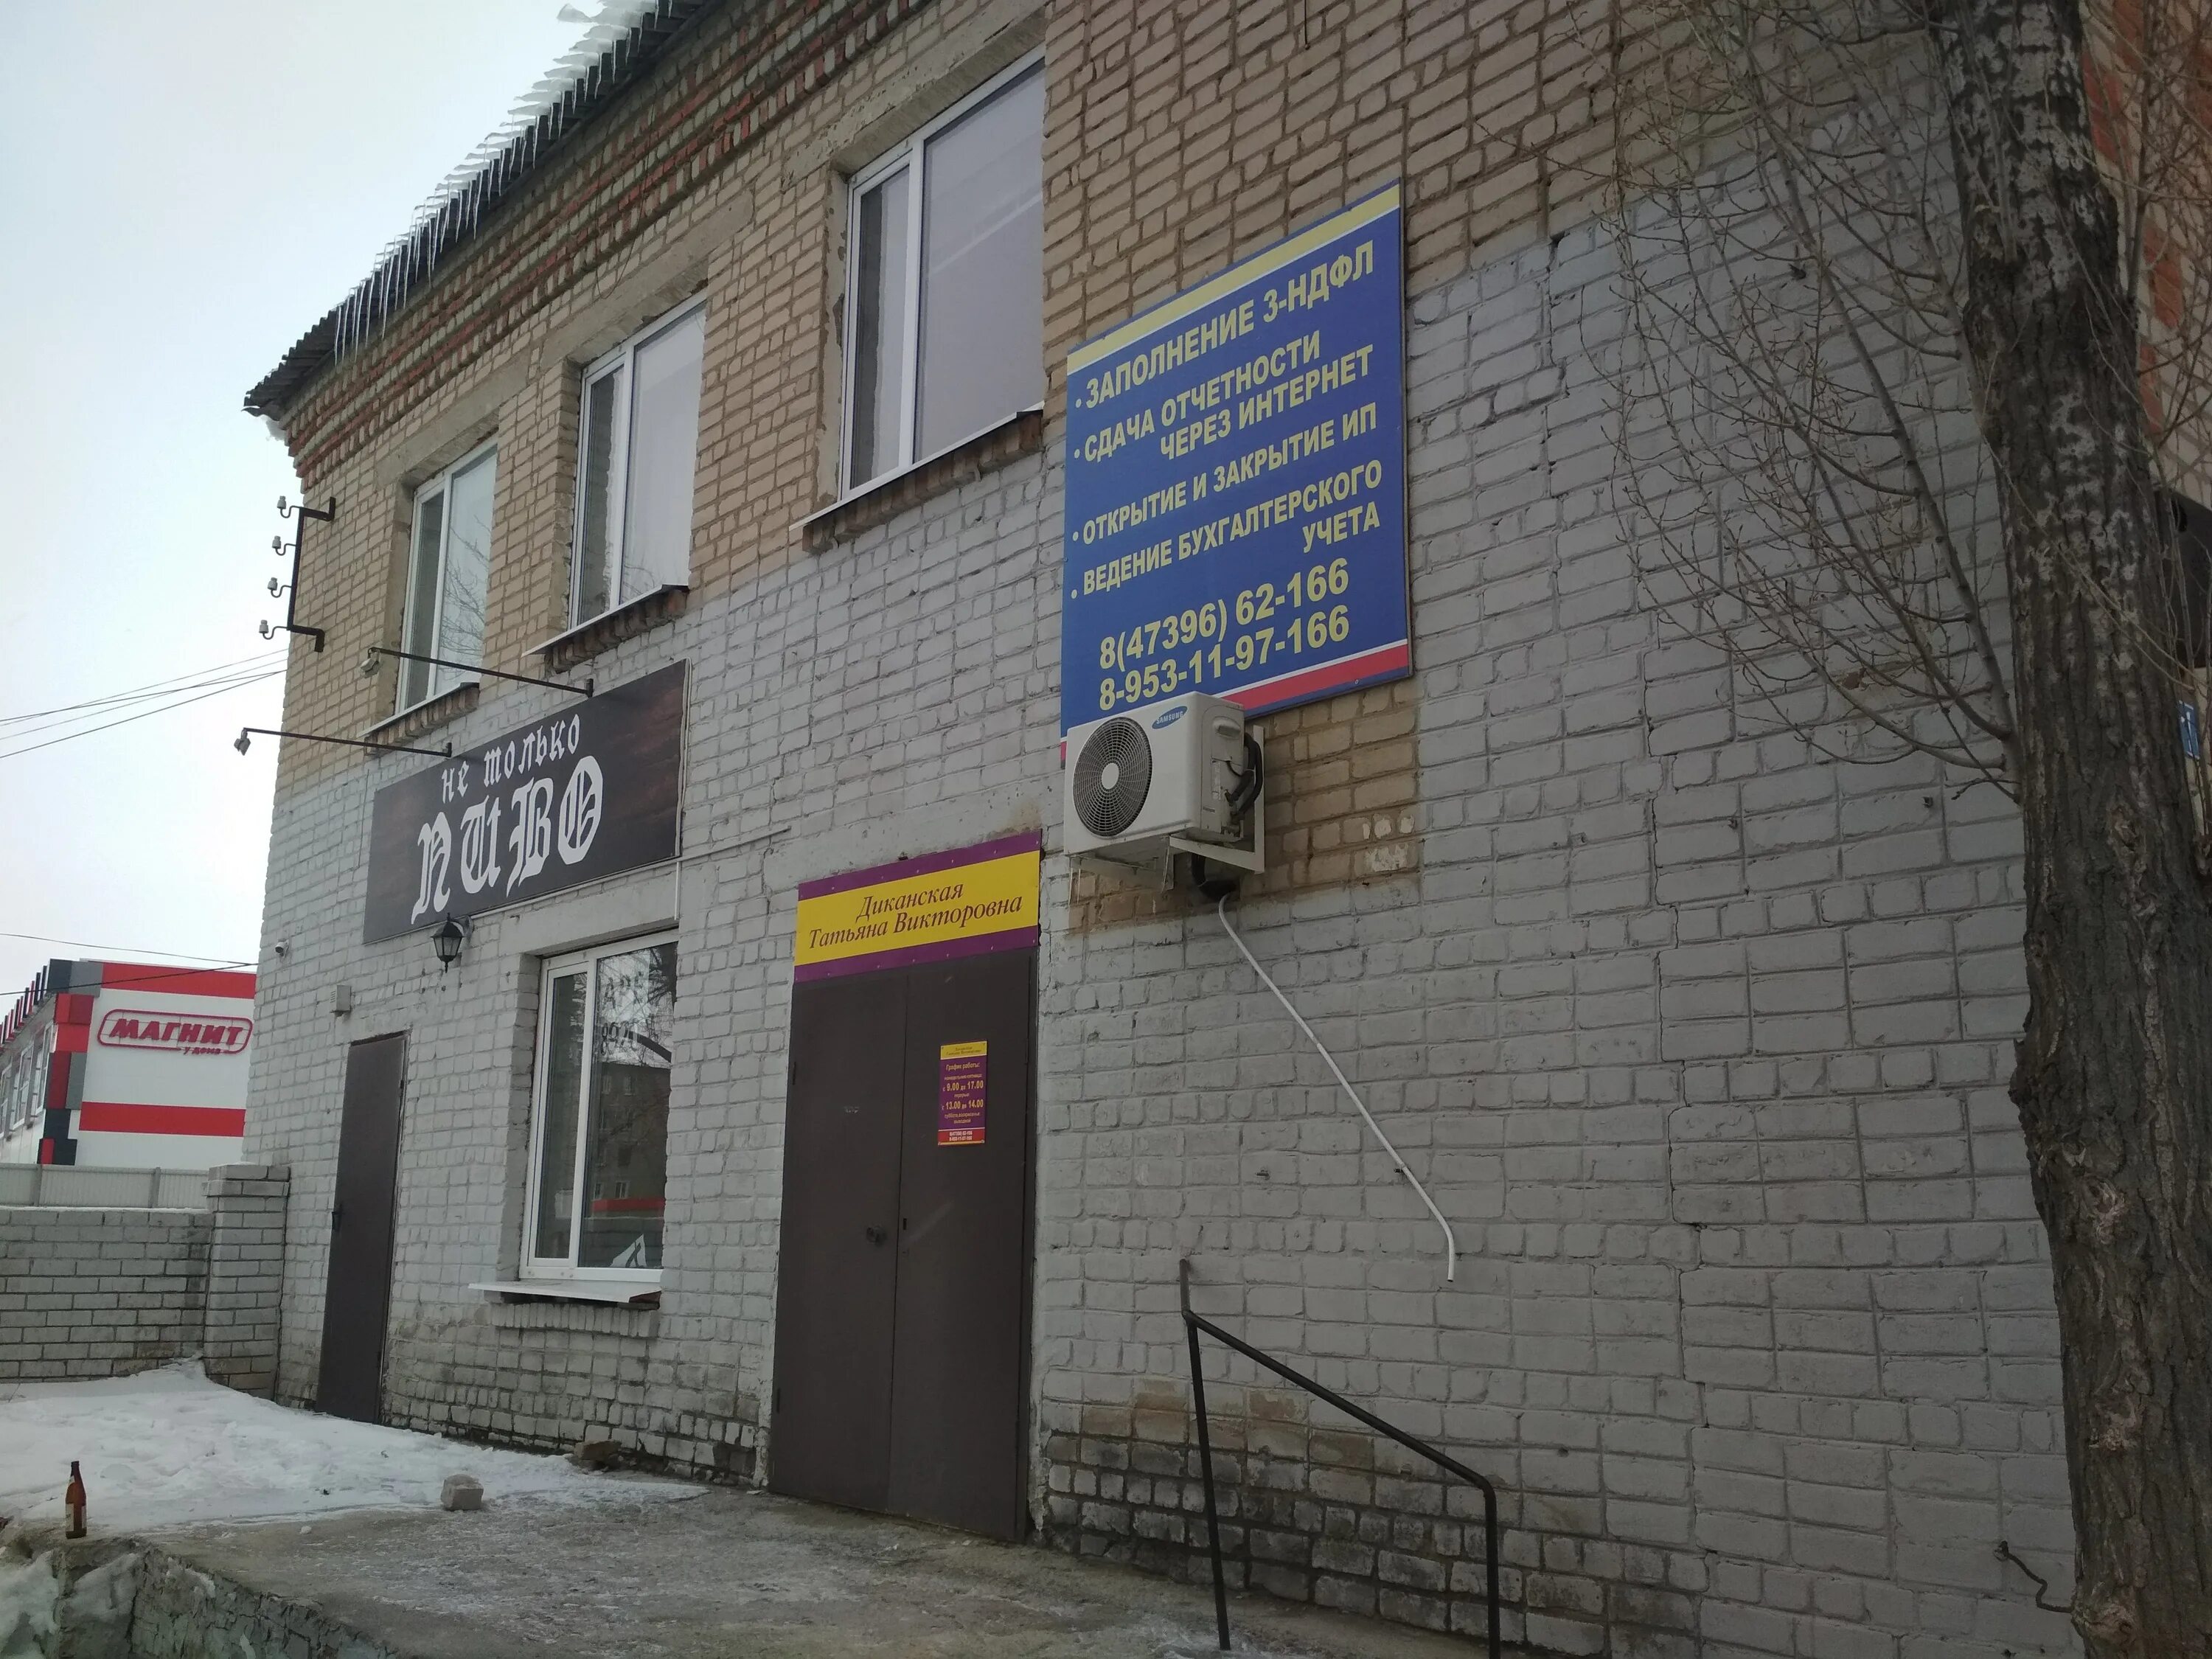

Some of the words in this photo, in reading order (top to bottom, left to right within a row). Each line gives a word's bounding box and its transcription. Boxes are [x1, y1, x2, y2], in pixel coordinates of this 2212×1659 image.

[1086, 299, 1254, 408] ЗАПОЛНЕНИЕ
[1263, 240, 1374, 322] 3-НДФЛ
[1085, 408, 1155, 462] СДАЧА
[1161, 330, 1320, 425] ОТЧЕТНОСТИ
[1161, 409, 1231, 460] ЧЕРЕЗ
[1239, 344, 1374, 429] ИНТЕРНЕТ
[1083, 481, 1186, 545] ОТКРЫТИЕ
[1193, 473, 1206, 501] И
[1213, 420, 1335, 493] ЗАКРЫТИЕ
[1343, 402, 1377, 441] ИП
[1083, 540, 1172, 596] ВЕДЕНИЕ
[1178, 459, 1382, 560] БУХГАЛТЕРСКОГО
[1302, 501, 1380, 553] УЧЕТА
[1100, 599, 1227, 672] 8(47396)
[1235, 557, 1349, 626] 62-166
[1099, 605, 1350, 711] 8-953-11-97-166
[1156, 711, 1183, 724] SAMSUNG
[442, 760, 469, 804] не
[810, 921, 888, 949] Татьяна
[893, 896, 1023, 933] Викторовна
[856, 883, 964, 922] Диканская
[109, 1018, 243, 1046] МАГНИТ
[947, 1082, 959, 1091] 9.00
[967, 1079, 984, 1090] 17.00
